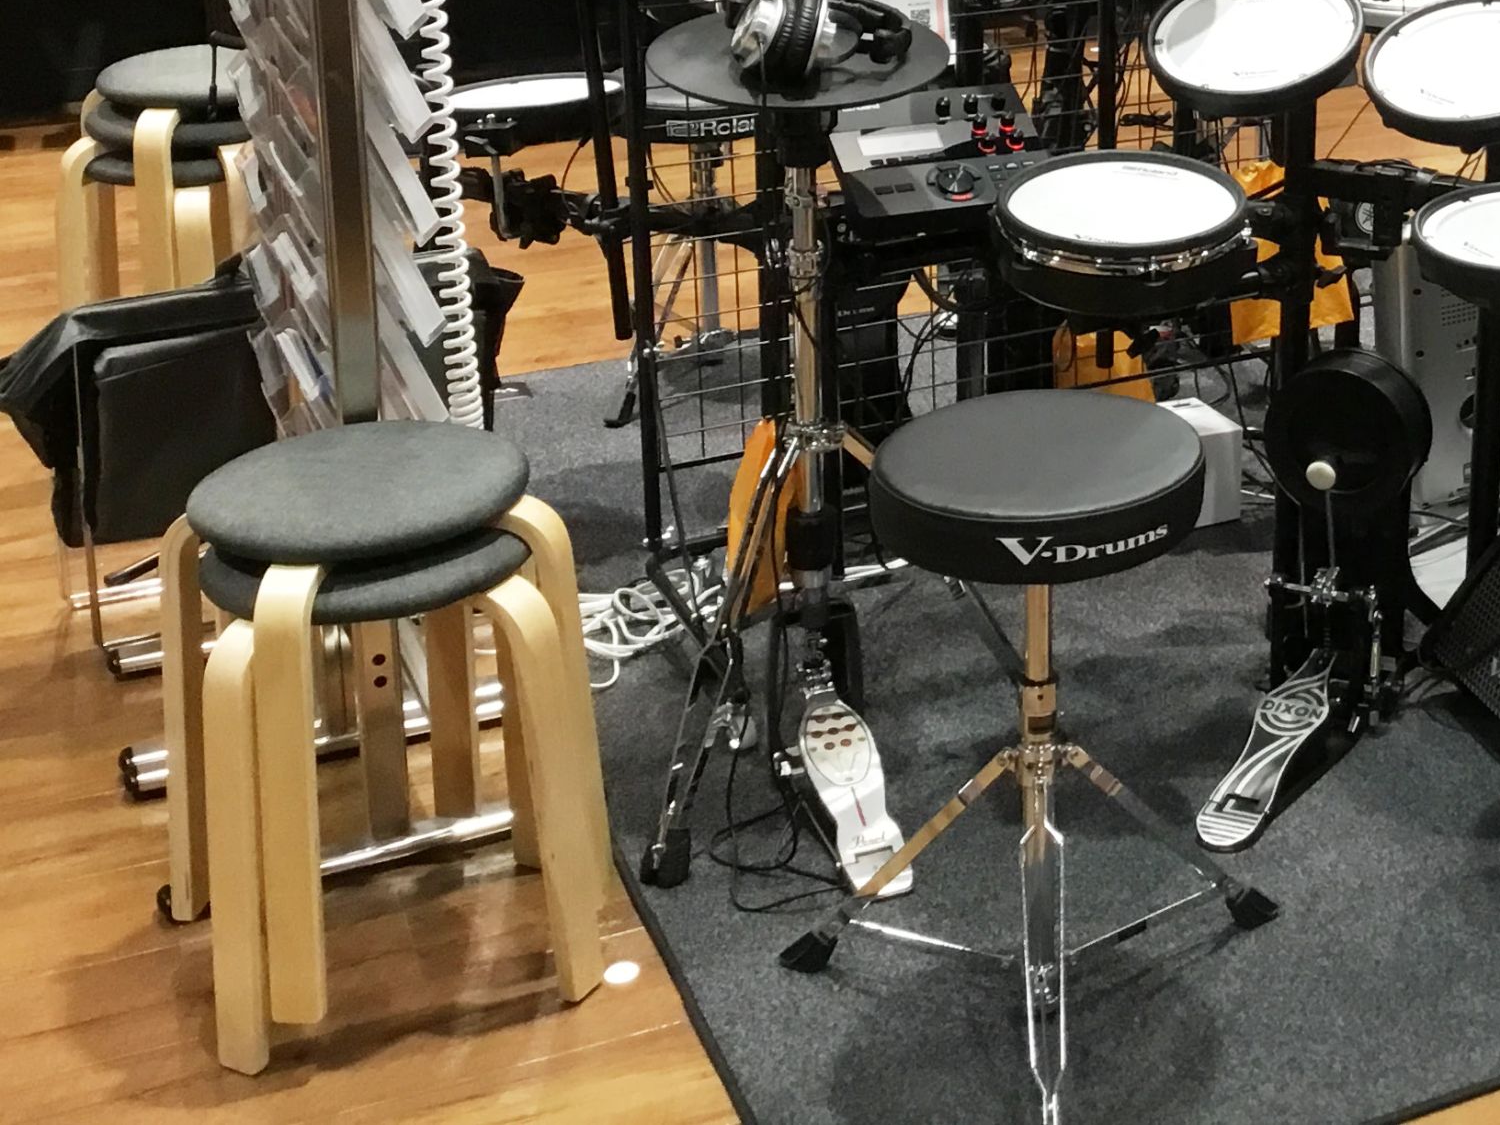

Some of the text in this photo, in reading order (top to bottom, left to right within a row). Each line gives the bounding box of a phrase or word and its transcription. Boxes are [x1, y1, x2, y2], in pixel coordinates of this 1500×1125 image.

[701, 118, 755, 137] Rola
[995, 524, 1169, 566] V-Drums
[1260, 699, 1324, 721] DIXON
